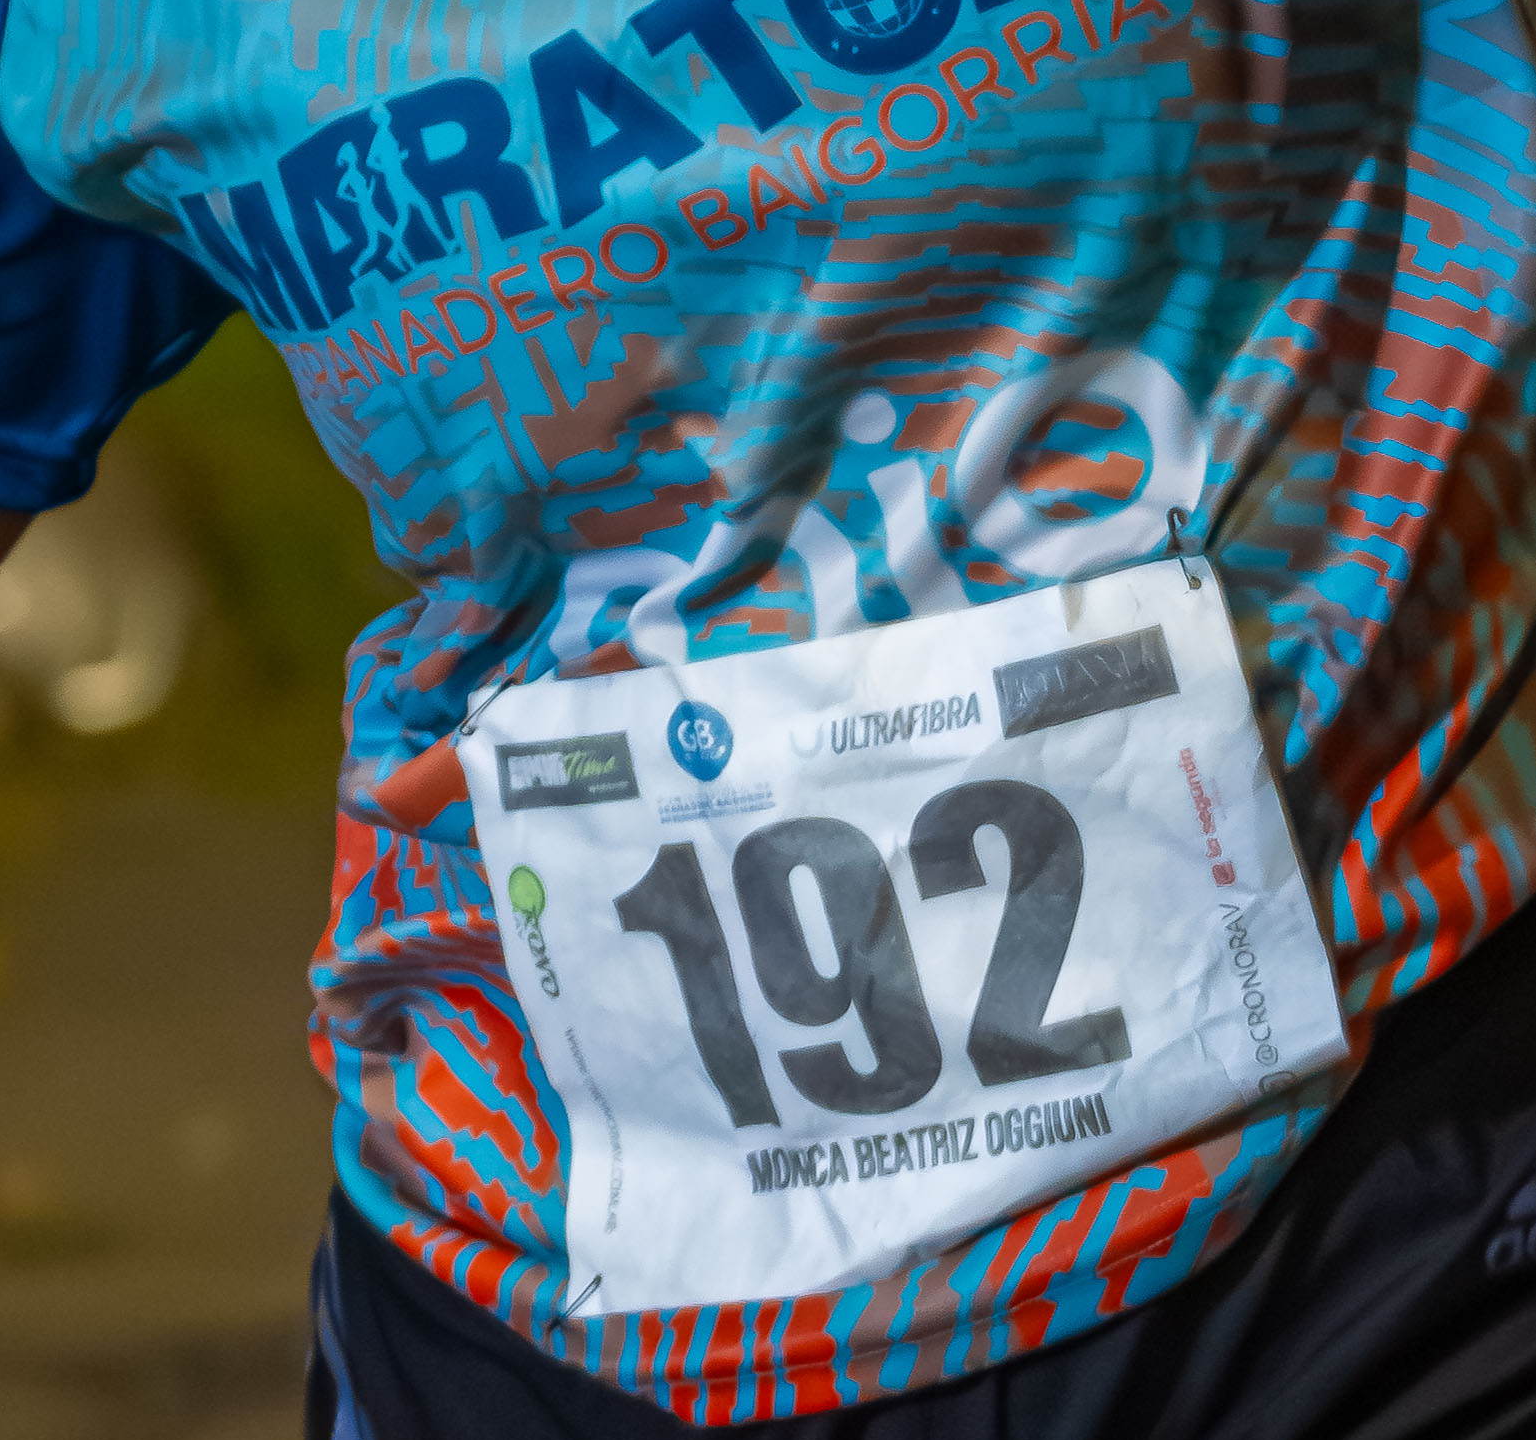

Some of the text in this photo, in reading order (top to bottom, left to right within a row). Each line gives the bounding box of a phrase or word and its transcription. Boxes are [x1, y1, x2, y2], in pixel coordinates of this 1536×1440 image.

[829, 691, 982, 756] ULTRAFIBRA
[612, 778, 1133, 1128] 192
[1218, 902, 1279, 1067] @CRONORAV
[746, 1092, 1112, 1195] MONCA BEATRIZ OGGIUNI
